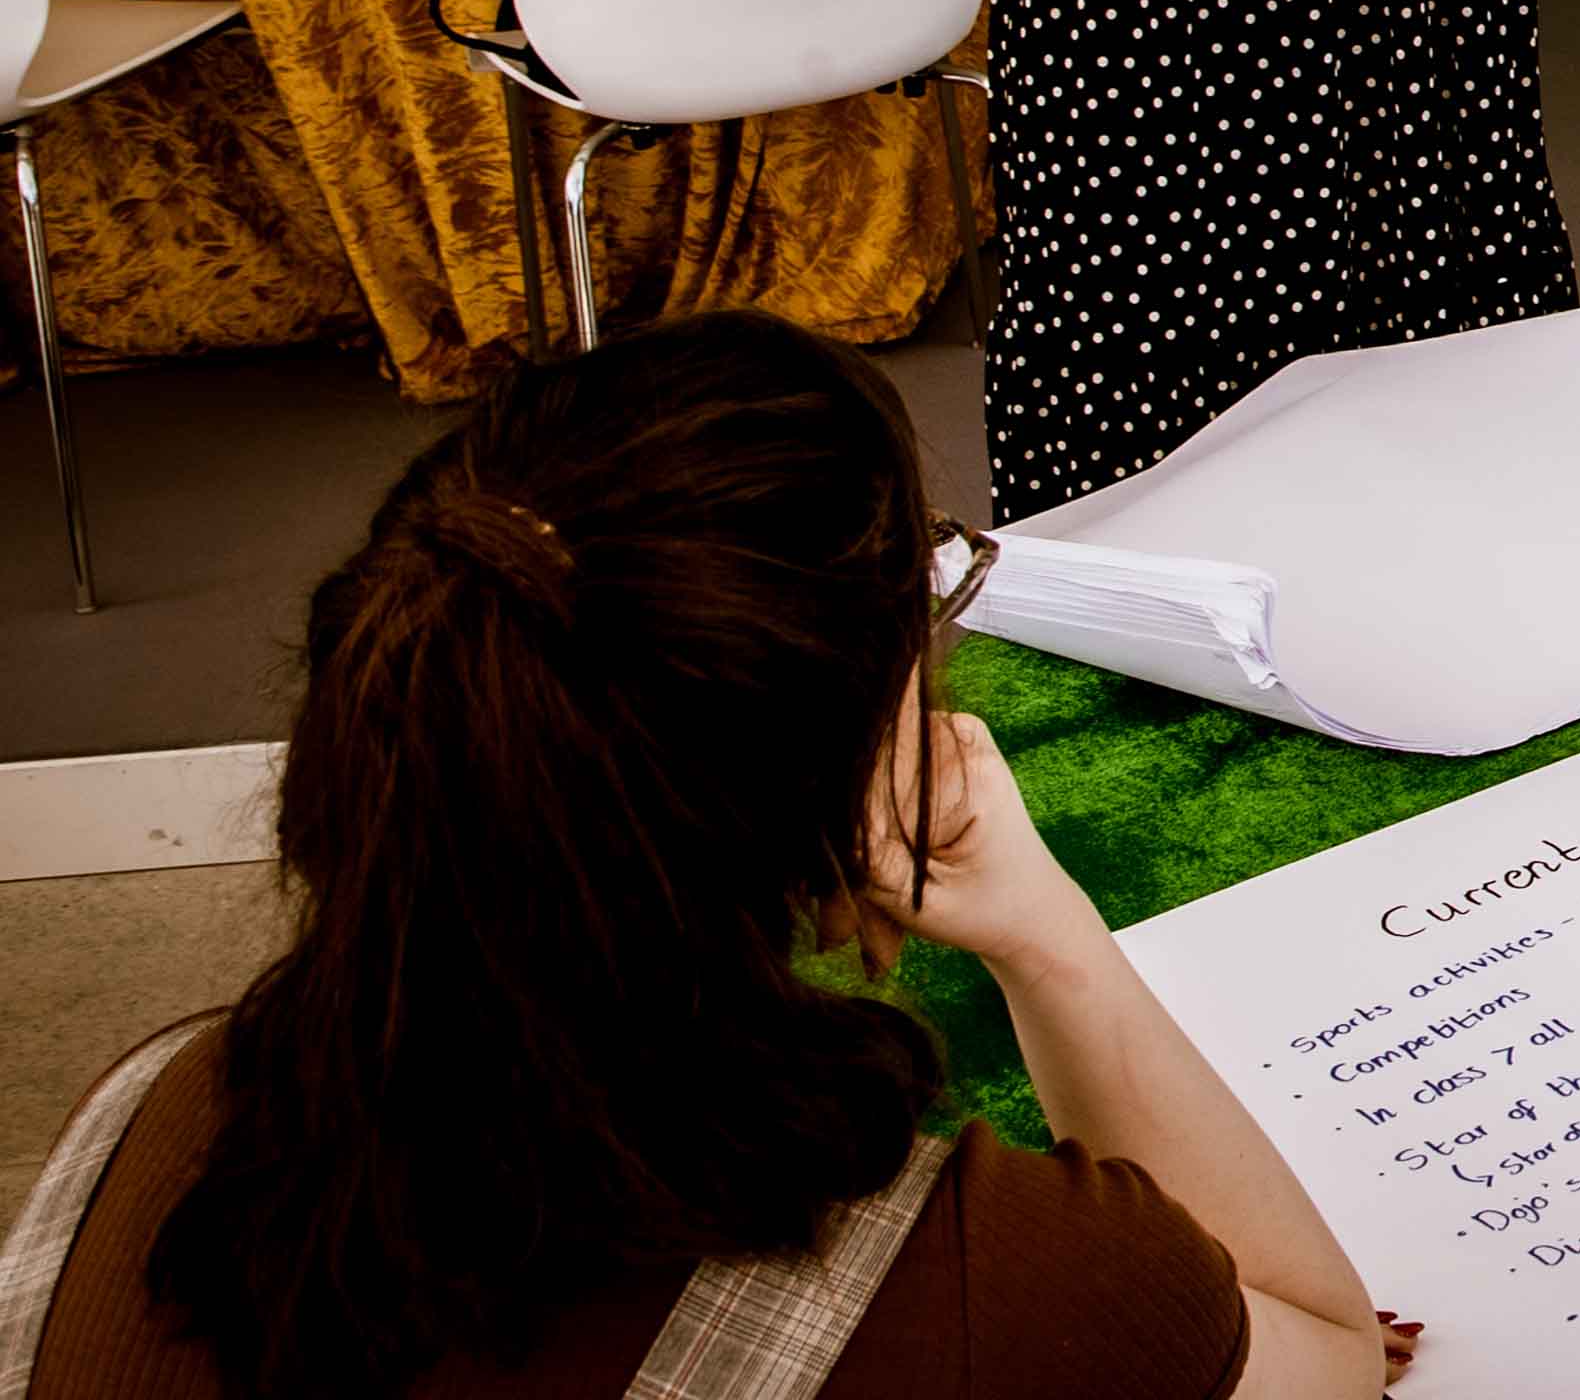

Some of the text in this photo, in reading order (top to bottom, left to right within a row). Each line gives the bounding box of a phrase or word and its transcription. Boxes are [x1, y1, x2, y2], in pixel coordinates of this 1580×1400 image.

[1290, 1002, 1394, 1054] Sports
[1408, 928, 1554, 998] activities
[1329, 987, 1532, 1083] Competitions
[1412, 1066, 1488, 1105] class
[1529, 1018, 1576, 1047] all
[1394, 1124, 1489, 1171] Star
[1507, 1098, 1538, 1122] of
